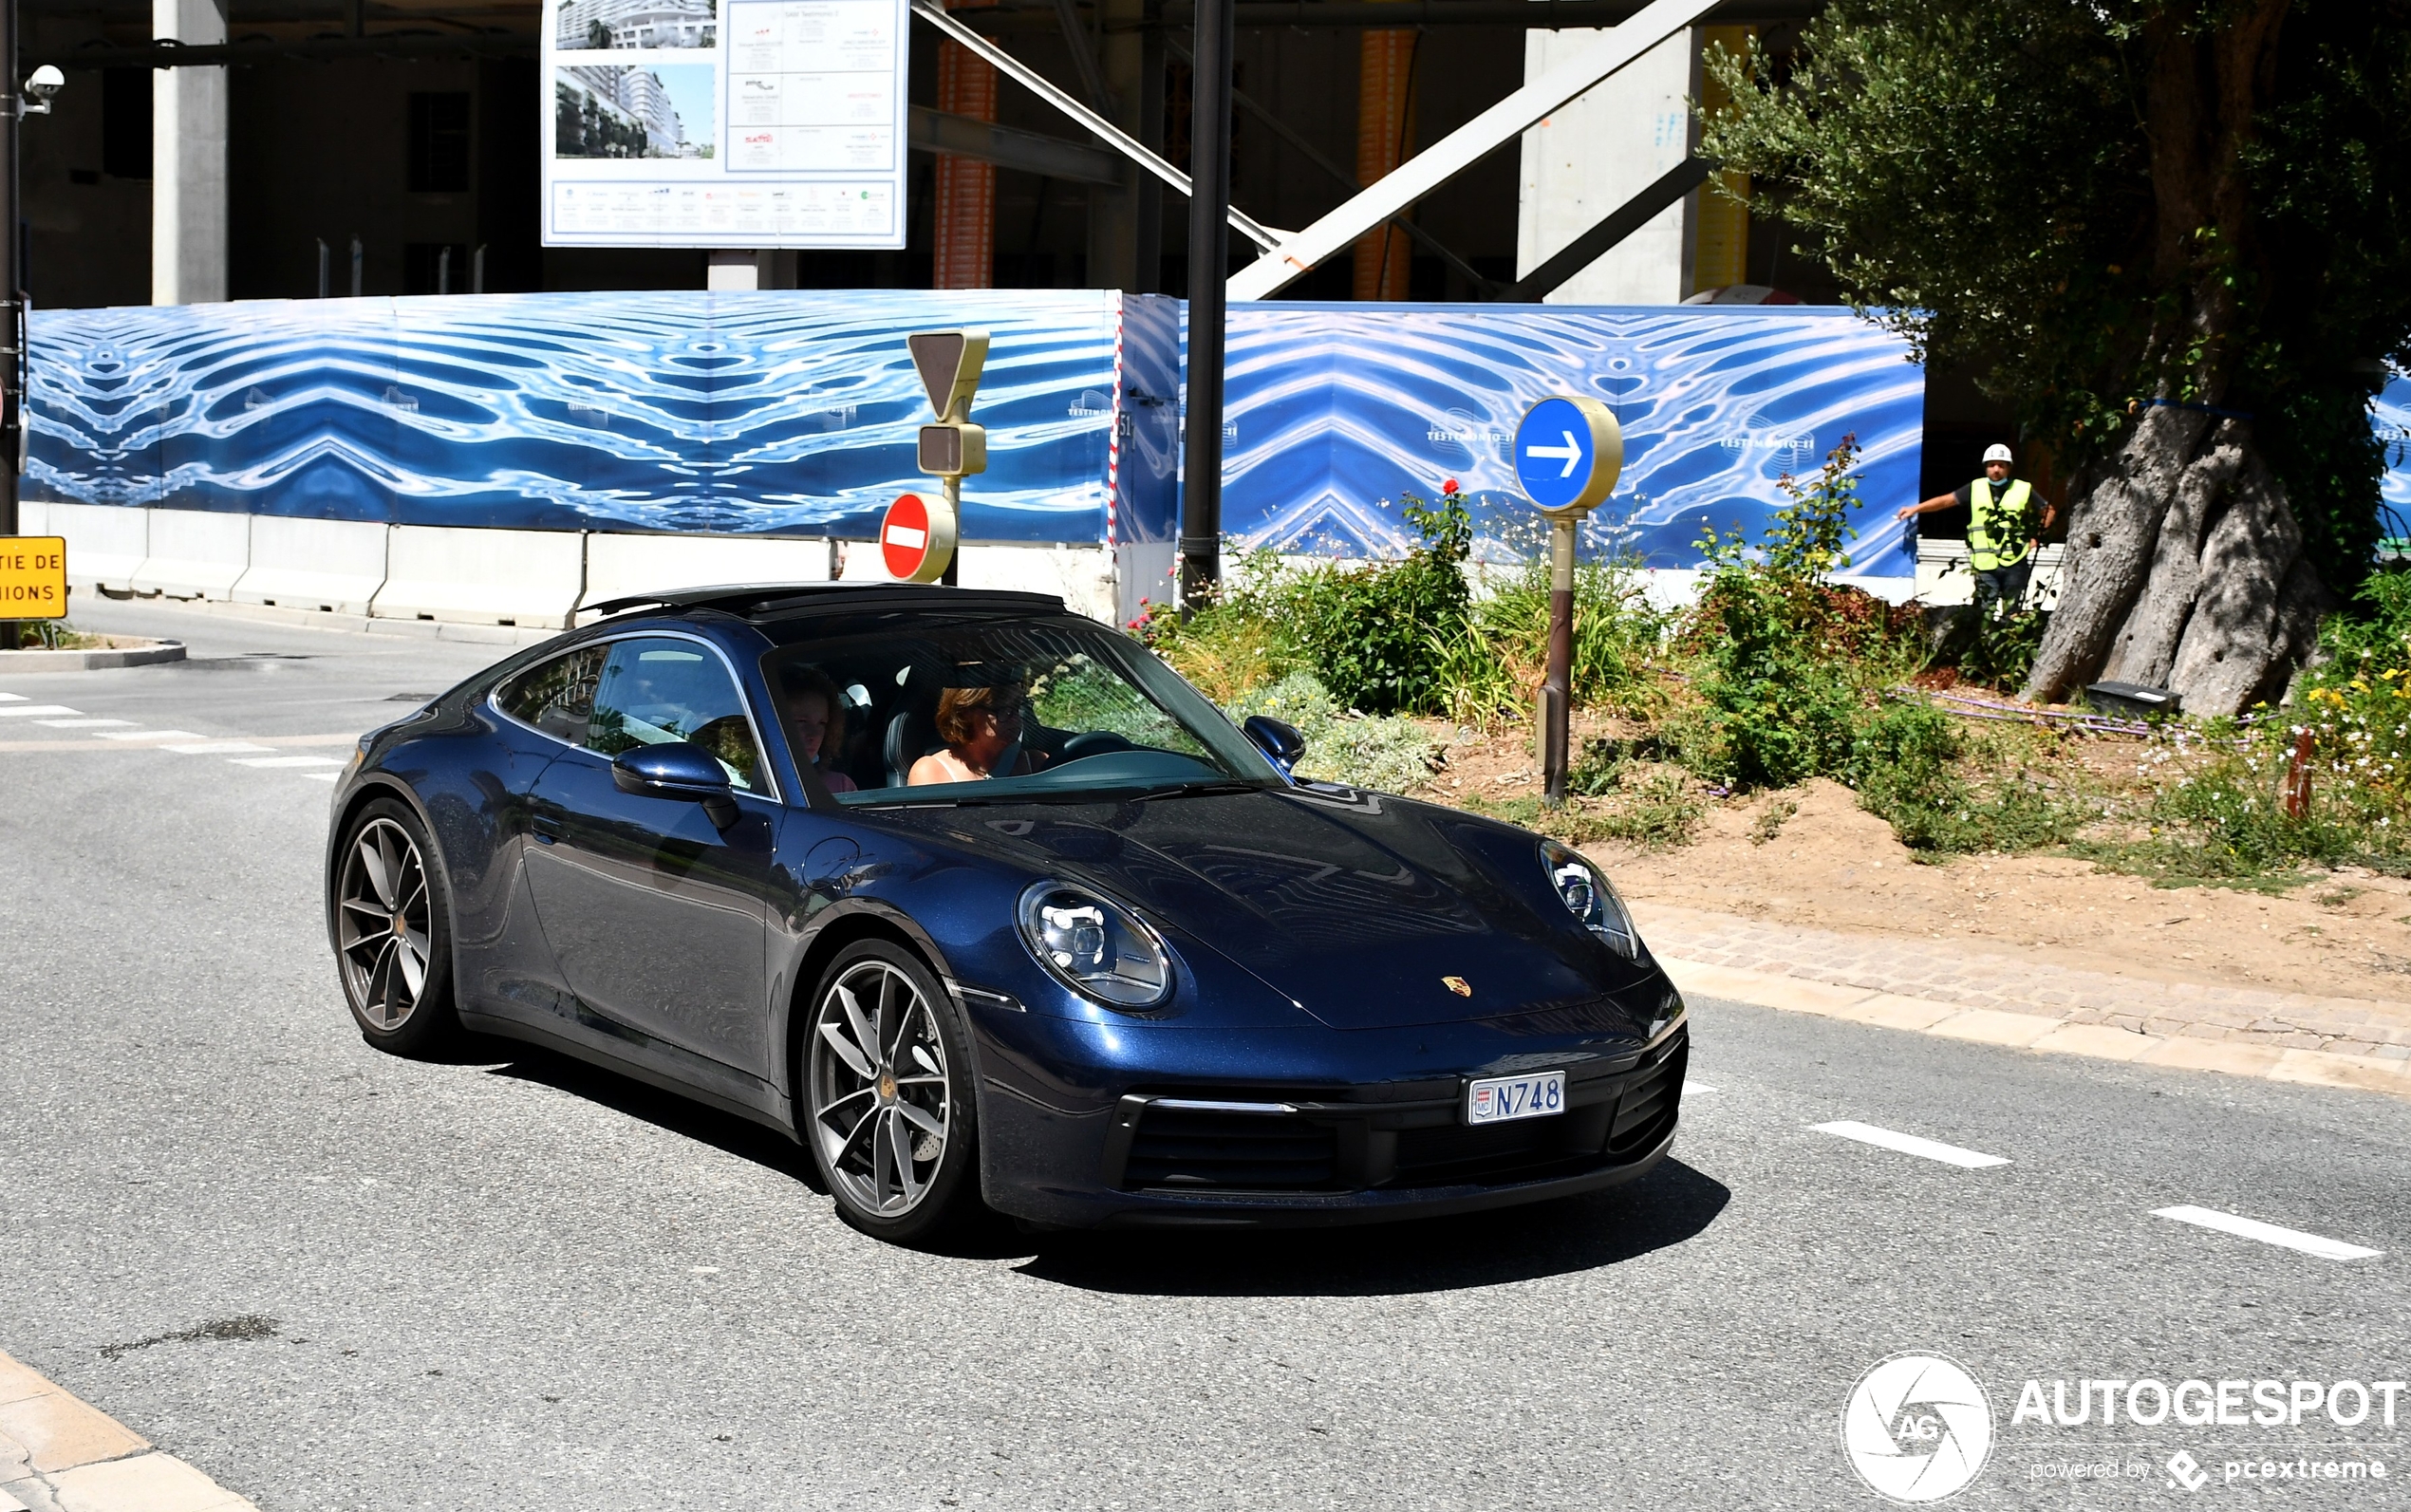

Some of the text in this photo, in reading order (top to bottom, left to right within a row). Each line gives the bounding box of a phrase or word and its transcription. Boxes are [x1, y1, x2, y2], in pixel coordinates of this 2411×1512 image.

[1427, 431, 1501, 442] TESTIMONIO
[1720, 438, 1798, 448] TESTIMONIO
[36, 554, 60, 569] DE
[0, 586, 54, 600] IONS
[1496, 1078, 1560, 1115] N748
